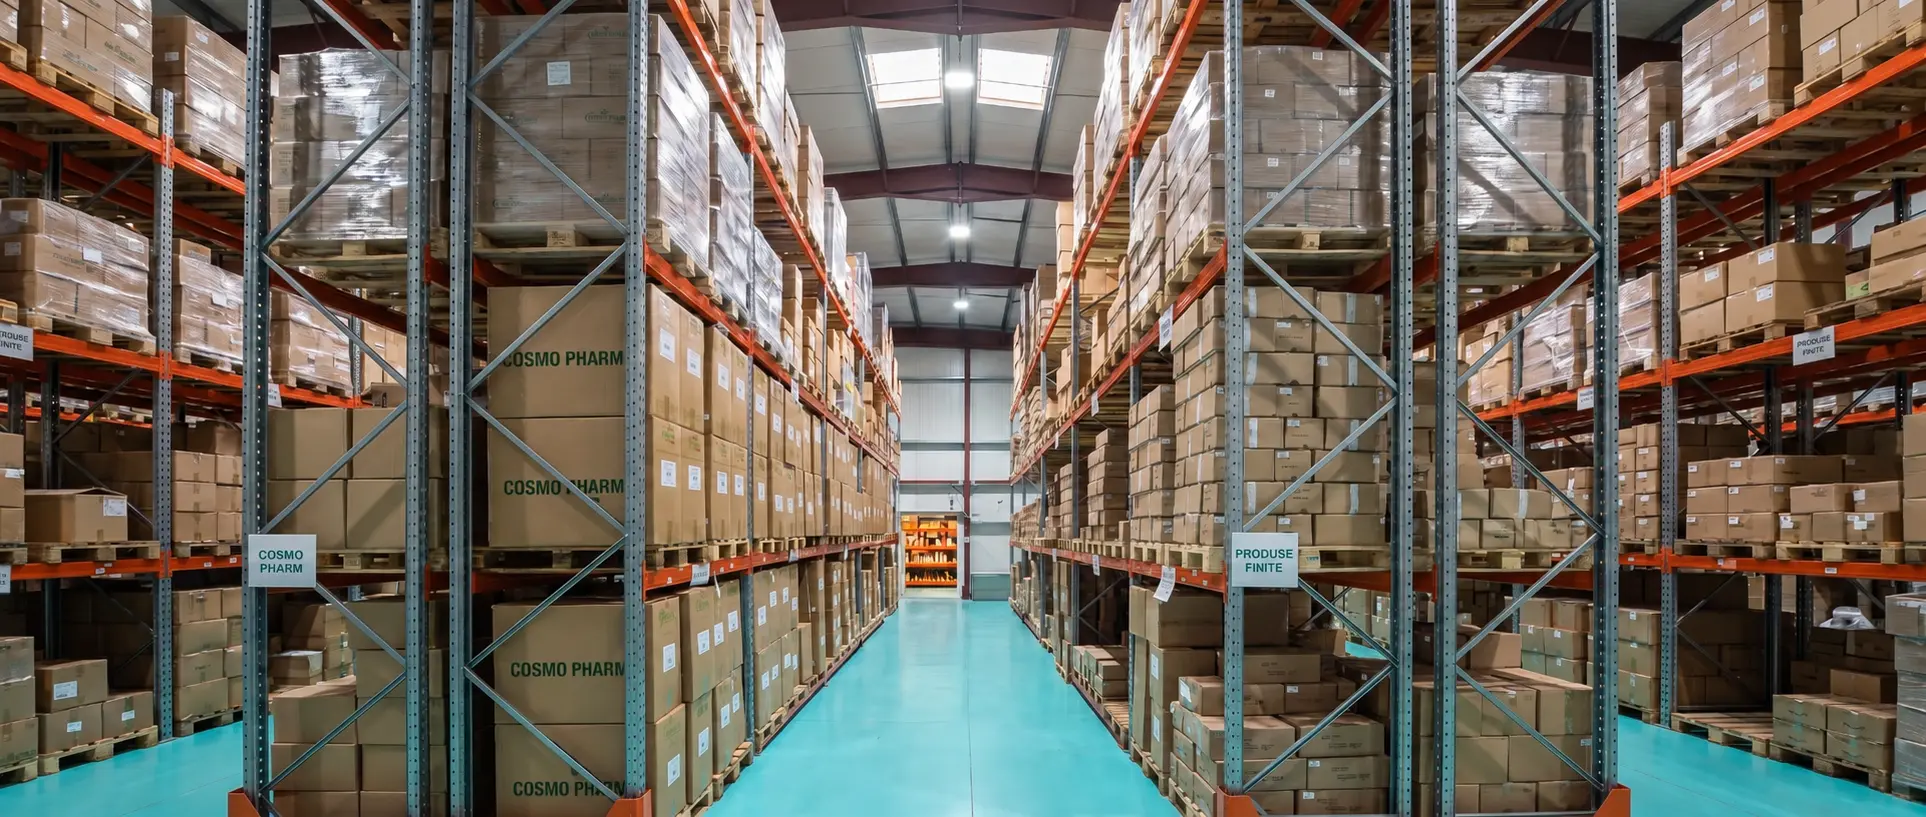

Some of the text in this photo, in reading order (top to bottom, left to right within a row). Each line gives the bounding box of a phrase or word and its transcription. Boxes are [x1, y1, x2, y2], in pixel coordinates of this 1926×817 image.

[504, 350, 623, 367] COSMO PHARM
[504, 480, 561, 495] COSMO
[259, 550, 303, 560] COSMO
[1235, 549, 1293, 559] PRODUSE
[260, 563, 303, 574] PHARM
[1245, 562, 1283, 573] FINITE
[511, 661, 625, 677] COSMO PHARM
[513, 781, 569, 797] COSMO
